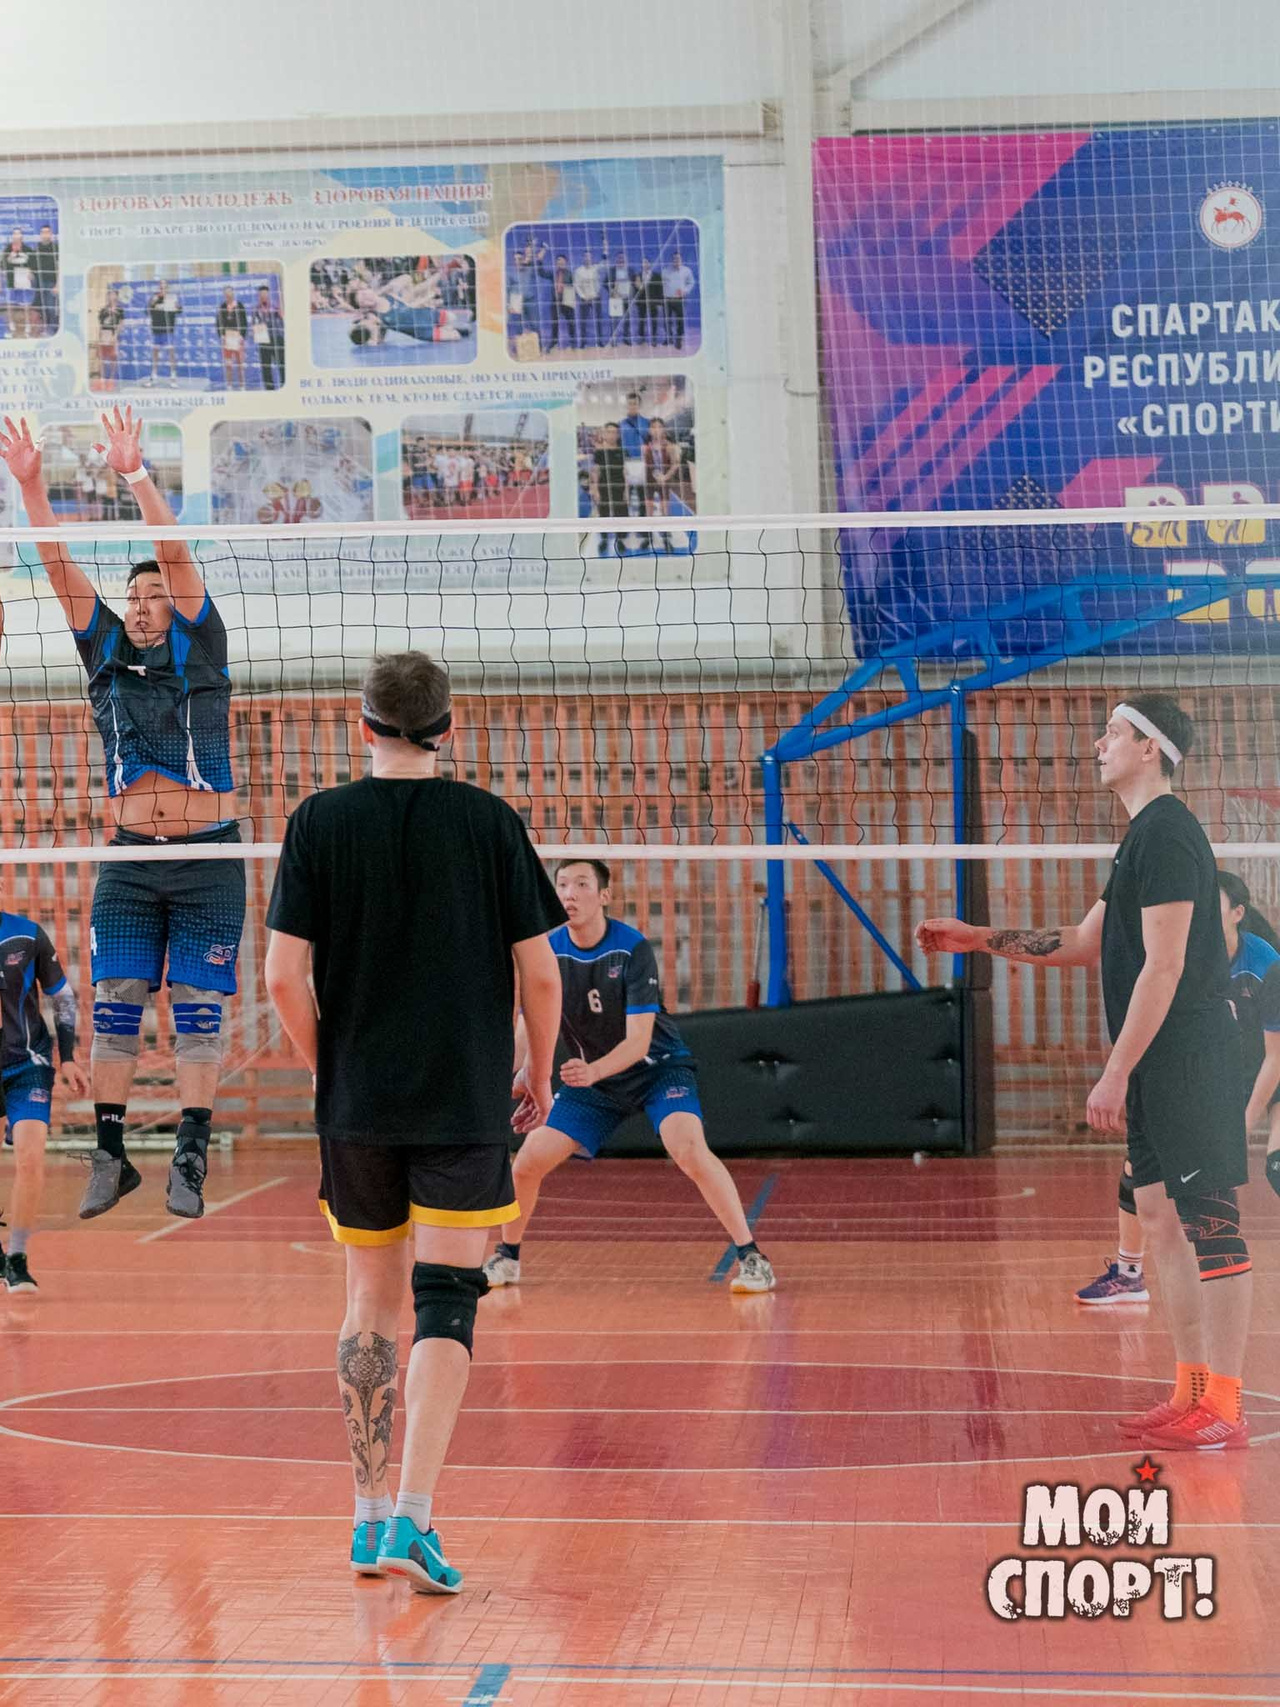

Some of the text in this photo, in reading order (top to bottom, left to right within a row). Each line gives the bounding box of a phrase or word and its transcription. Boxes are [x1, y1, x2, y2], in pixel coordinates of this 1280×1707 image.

[79, 195, 173, 212] ЗДОРОВАЯ
[181, 192, 293, 209] МОЛОДЕЖЬ
[313, 188, 410, 206] ЗДОРОВАЯ
[416, 185, 492, 202] НАЦИЯ!
[1112, 301, 1280, 338] СПАРТАК
[1083, 350, 1280, 388] РЕСПУБЛИ
[587, 988, 603, 1013] 6
